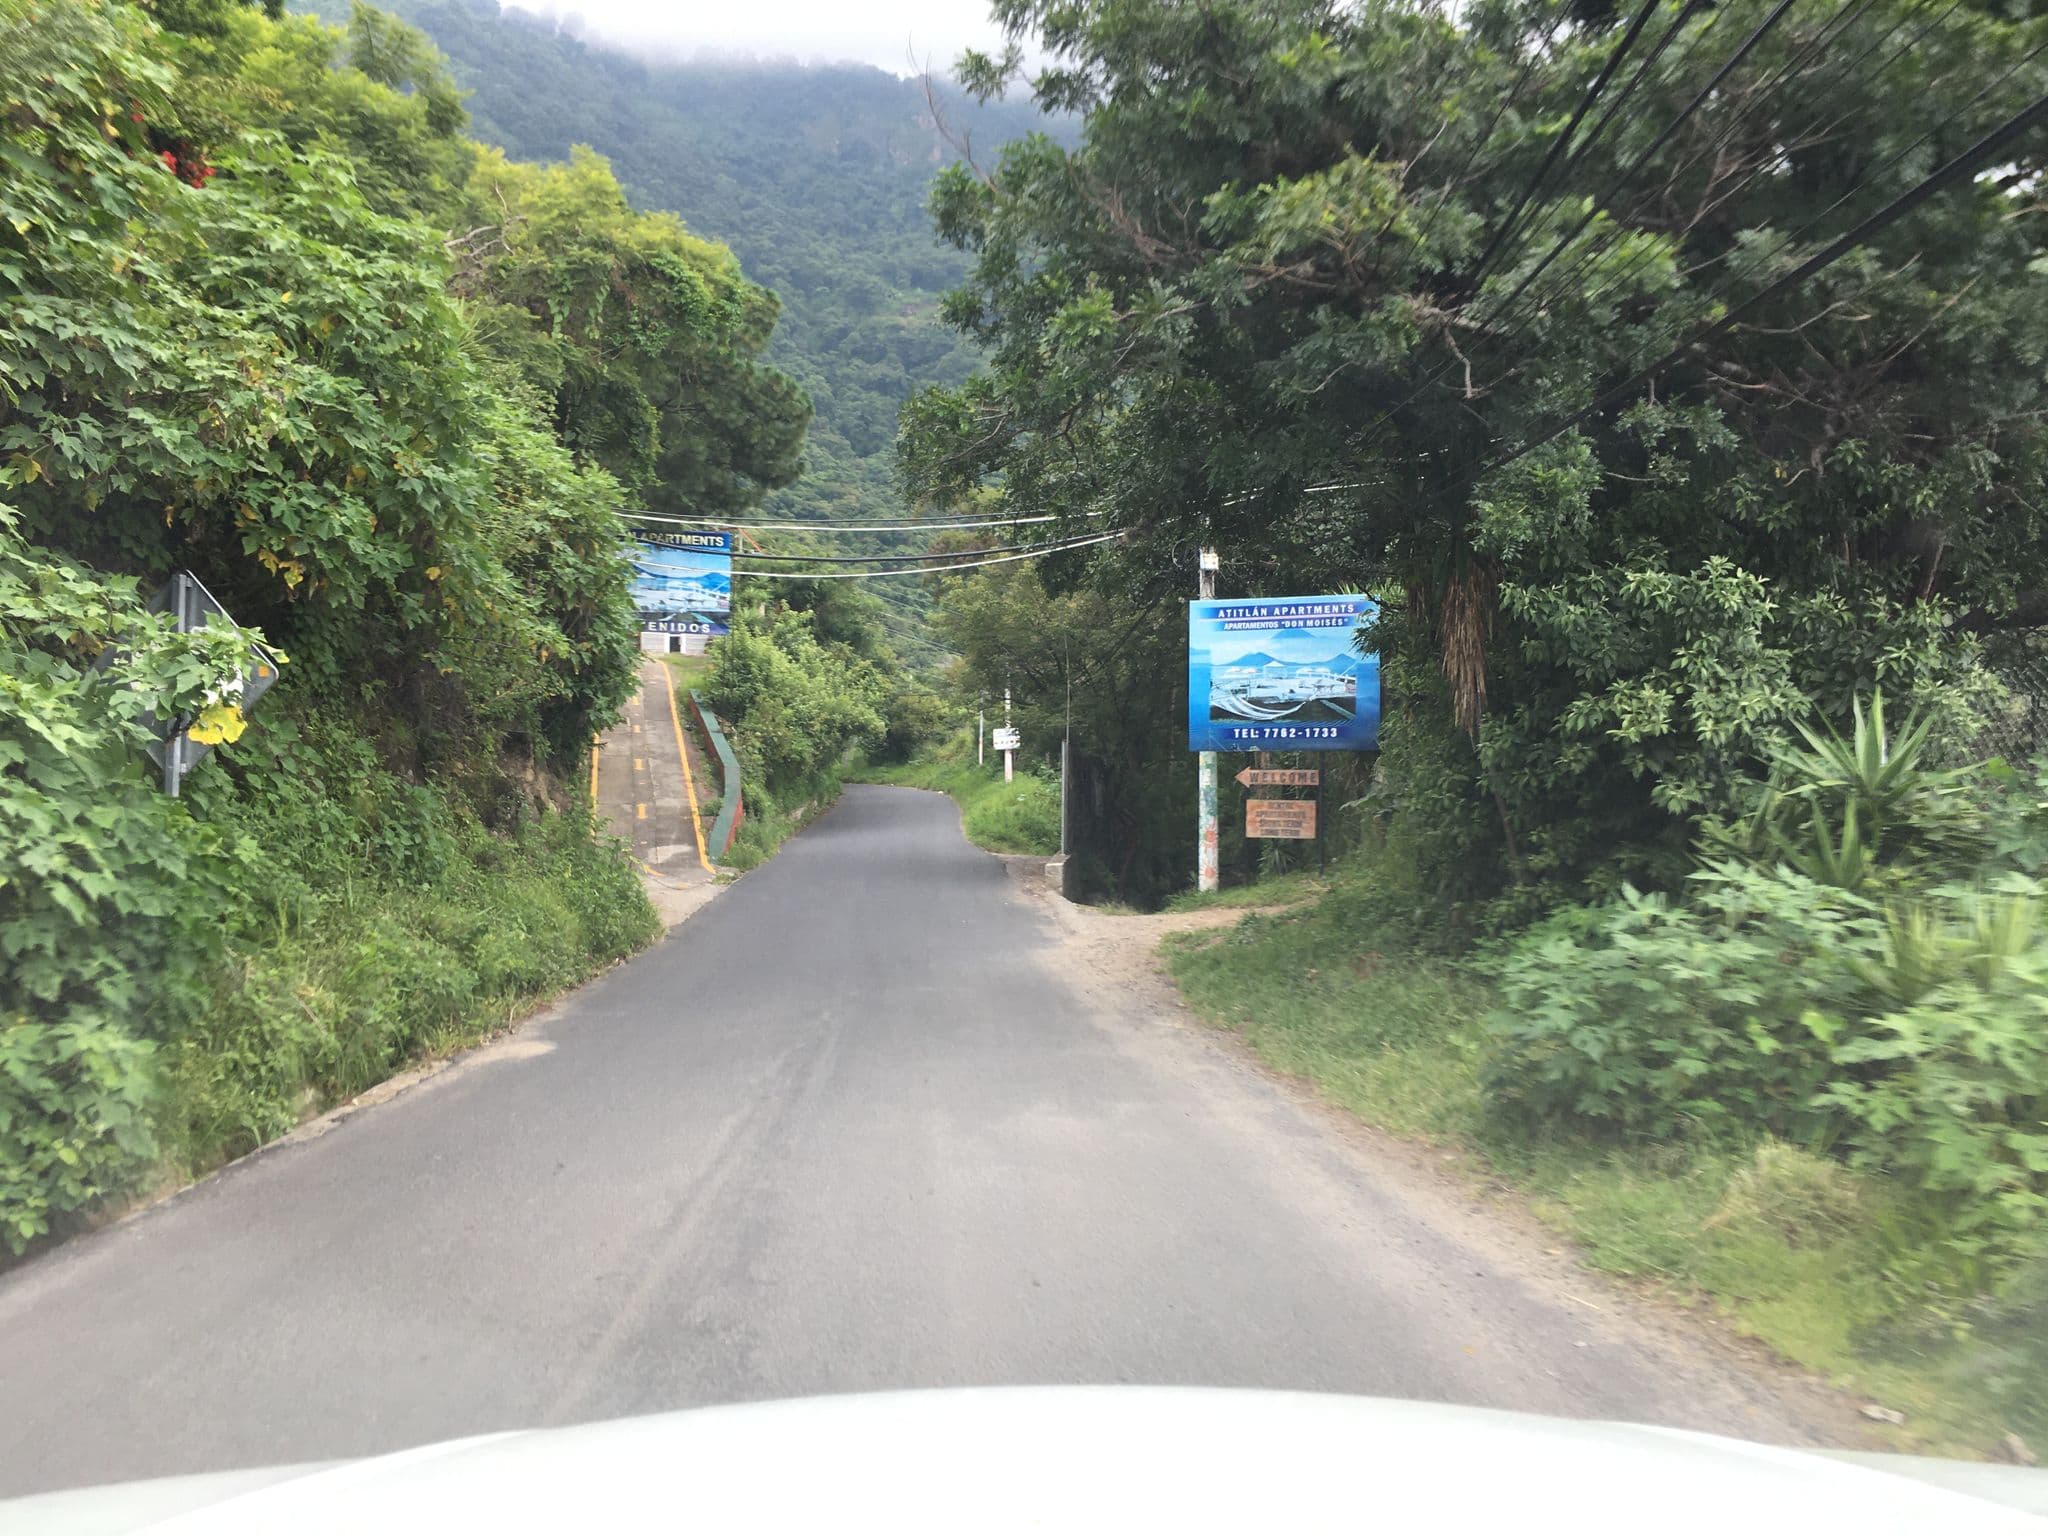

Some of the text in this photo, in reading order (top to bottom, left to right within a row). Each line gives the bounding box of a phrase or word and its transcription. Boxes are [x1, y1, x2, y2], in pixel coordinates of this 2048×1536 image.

[640, 532, 724, 547] APARTMENTS
[1218, 603, 1355, 618] ATITLÁN APARTMENTS
[642, 621, 711, 633] ENIDOS
[1224, 620, 1278, 630] APARTAMENTOS
[1234, 727, 1338, 739] TEL: 7762-1733
[1249, 771, 1317, 783] WELCOME
